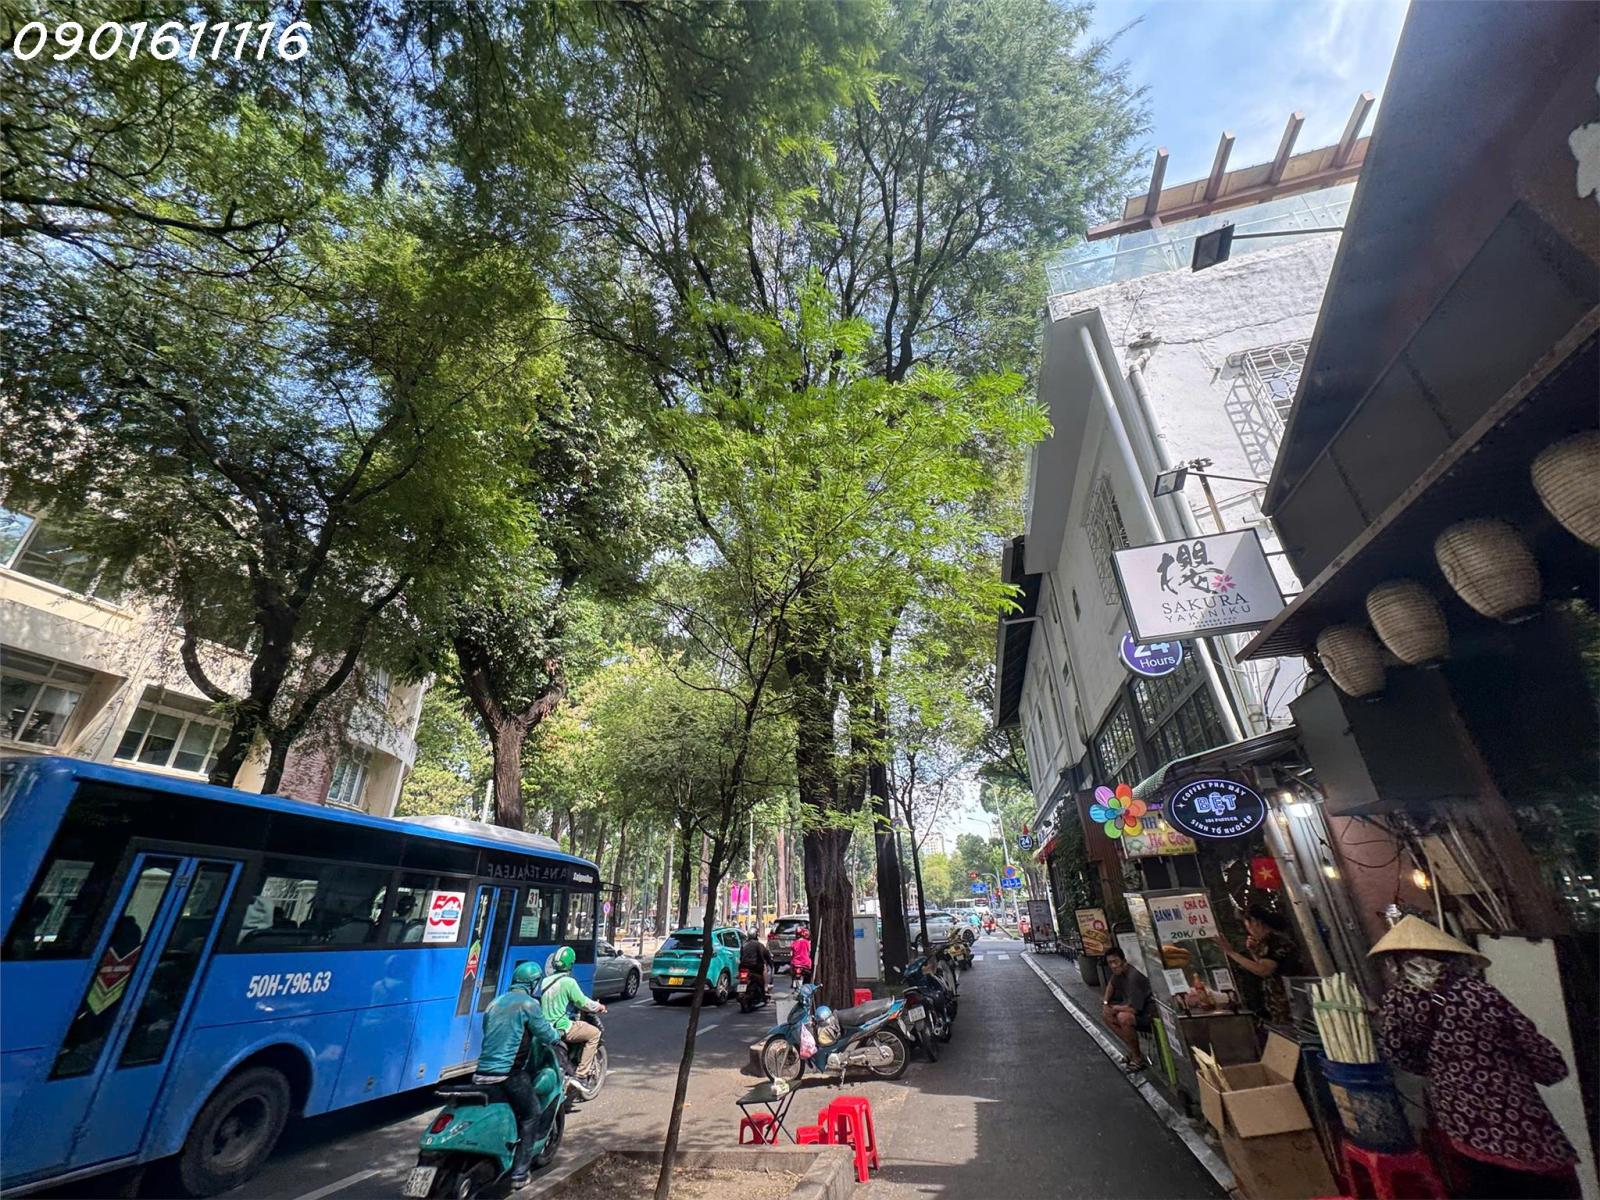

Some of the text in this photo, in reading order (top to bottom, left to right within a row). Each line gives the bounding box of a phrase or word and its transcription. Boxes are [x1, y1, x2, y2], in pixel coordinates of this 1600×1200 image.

[1162, 592, 1248, 615] SAKURA
[1165, 604, 1251, 623] YAKINIKU
[1139, 656, 1176, 669] Hours
[1181, 782, 1206, 802] COFFEE
[528, 892, 539, 905] 31
[245, 970, 332, 999] 50H-796.63
